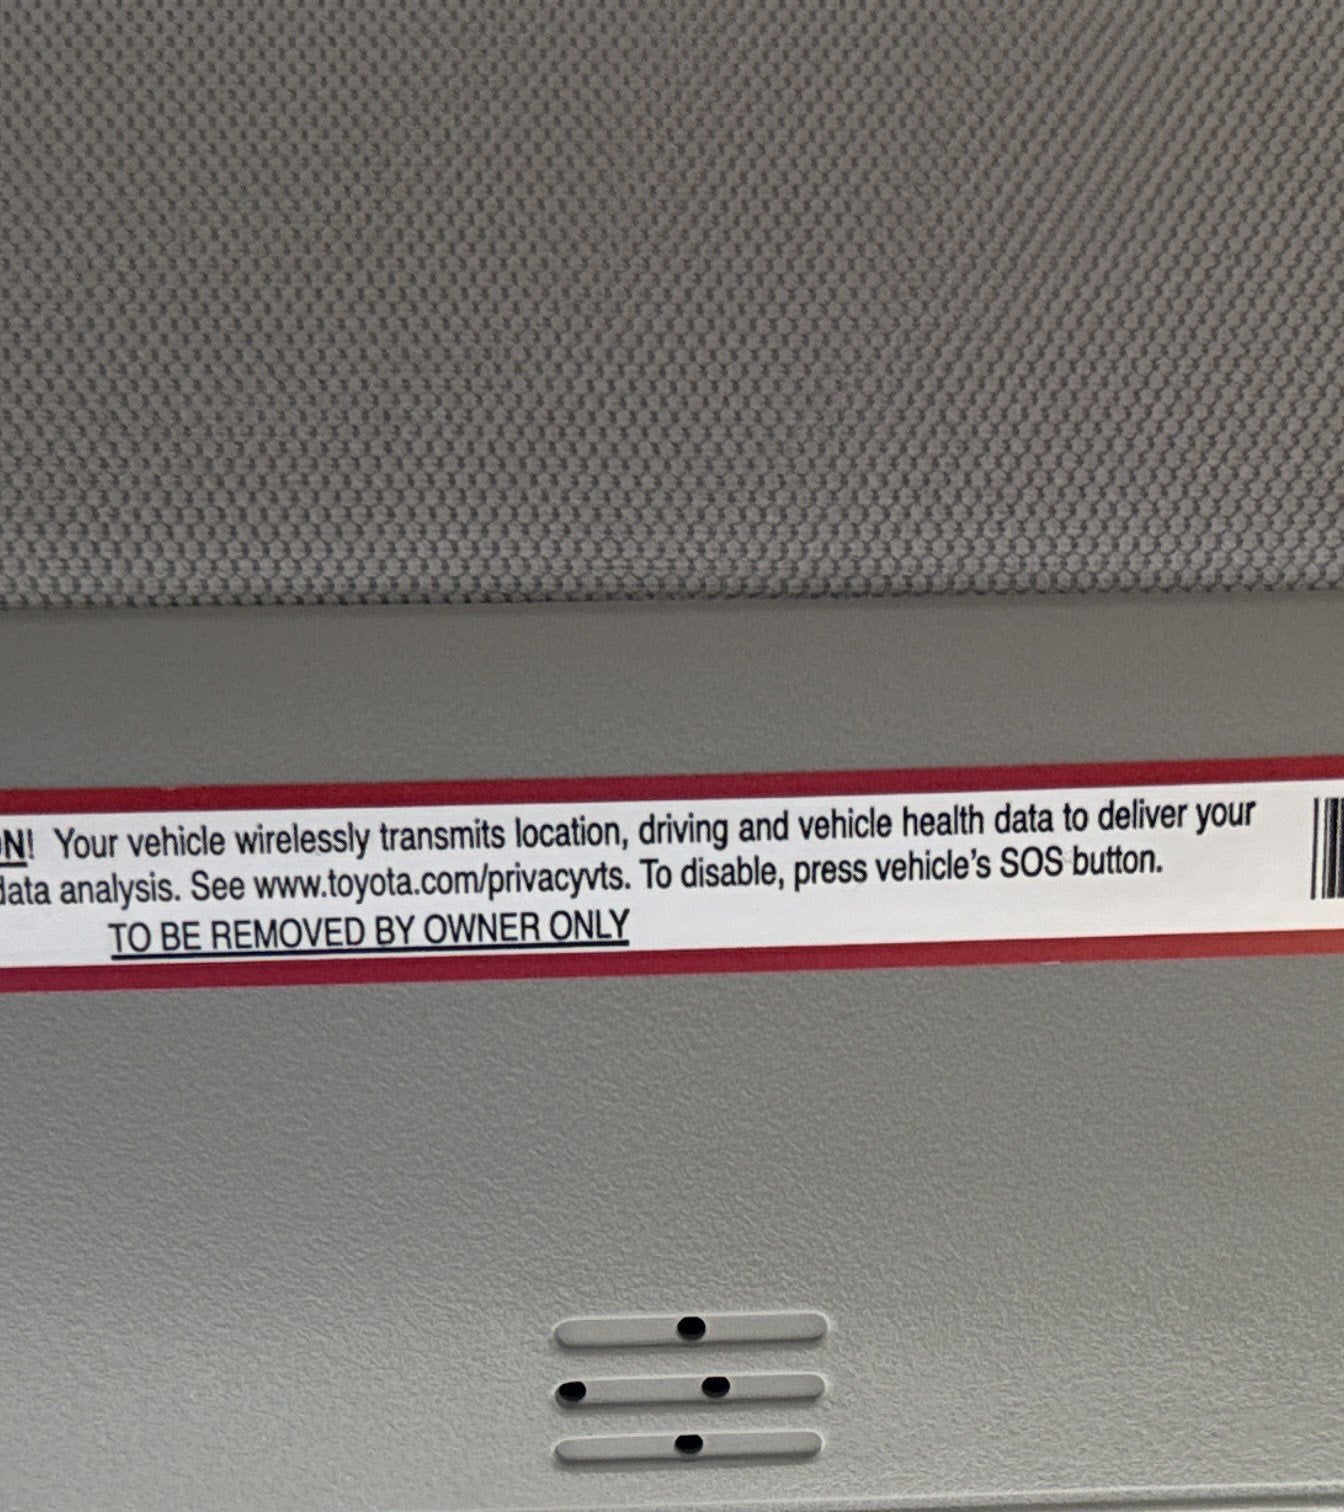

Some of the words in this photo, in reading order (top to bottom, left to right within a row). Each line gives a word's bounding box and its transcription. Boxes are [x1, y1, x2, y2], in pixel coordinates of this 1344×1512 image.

[56, 827, 118, 858] Your
[127, 825, 225, 857] vehicle
[236, 822, 370, 859] wirelessly
[380, 818, 505, 853] transmits
[515, 815, 628, 849] location,
[639, 812, 728, 850] driving
[739, 810, 788, 842] and
[798, 808, 892, 840] vehicle
[903, 802, 984, 837] health
[995, 801, 1053, 833] data
[1063, 802, 1089, 832] to
[1097, 798, 1188, 830] deliver
[1196, 800, 1256, 835] your
[60, 872, 180, 910] analysis.
[191, 870, 245, 901] See
[254, 861, 631, 903] www.toyota.com/privacyvts.
[639, 858, 672, 889] To
[681, 855, 783, 890] disable,
[794, 857, 867, 892] press
[1000, 846, 1063, 878] SOS
[1072, 845, 1163, 876] button.
[109, 922, 151, 953] TO
[161, 920, 201, 951] BE
[212, 916, 365, 949] REMOVED
[375, 914, 415, 946] BY
[424, 910, 540, 945] OWNER
[550, 908, 630, 940] ONLY
